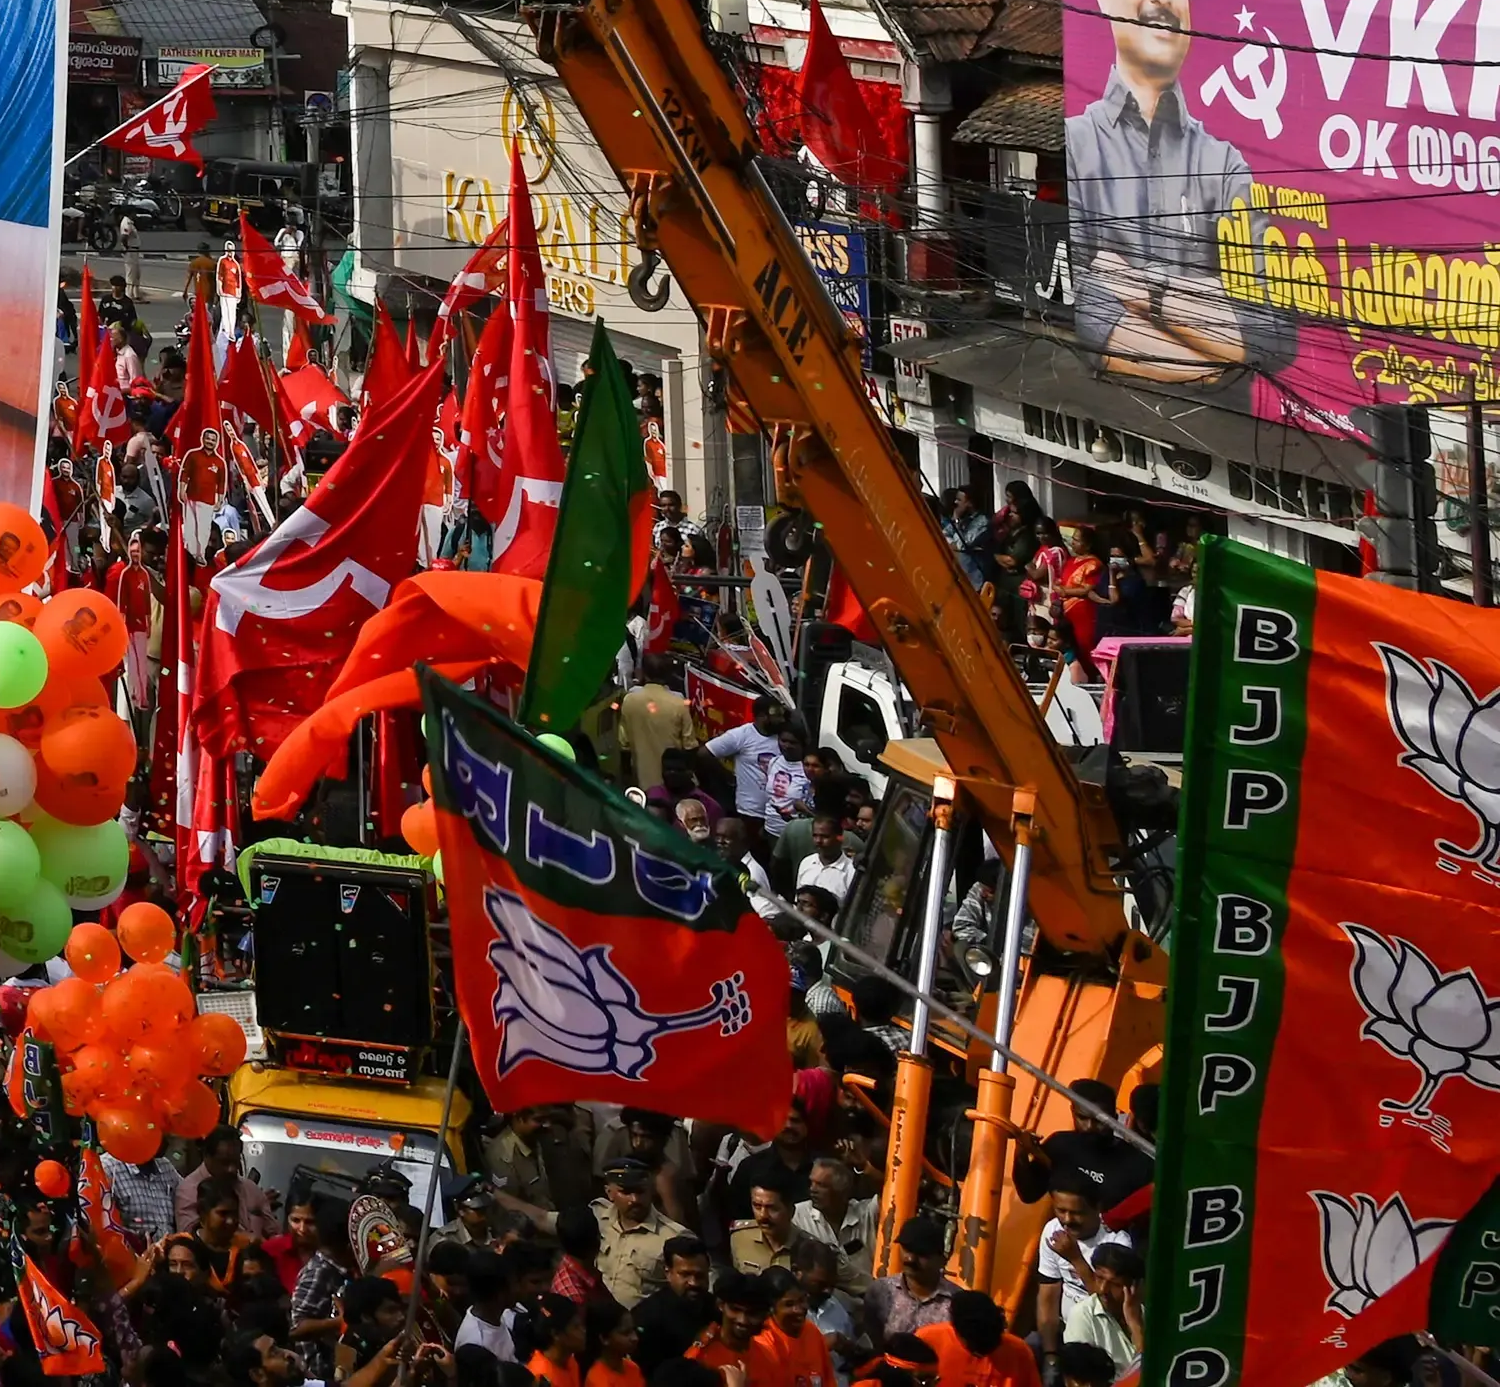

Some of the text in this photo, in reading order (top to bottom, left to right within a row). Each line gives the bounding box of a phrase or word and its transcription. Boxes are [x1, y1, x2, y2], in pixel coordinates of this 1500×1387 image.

[161, 49, 261, 58] RATHEESH FLOWER MART
[1319, 113, 1398, 180] OK
